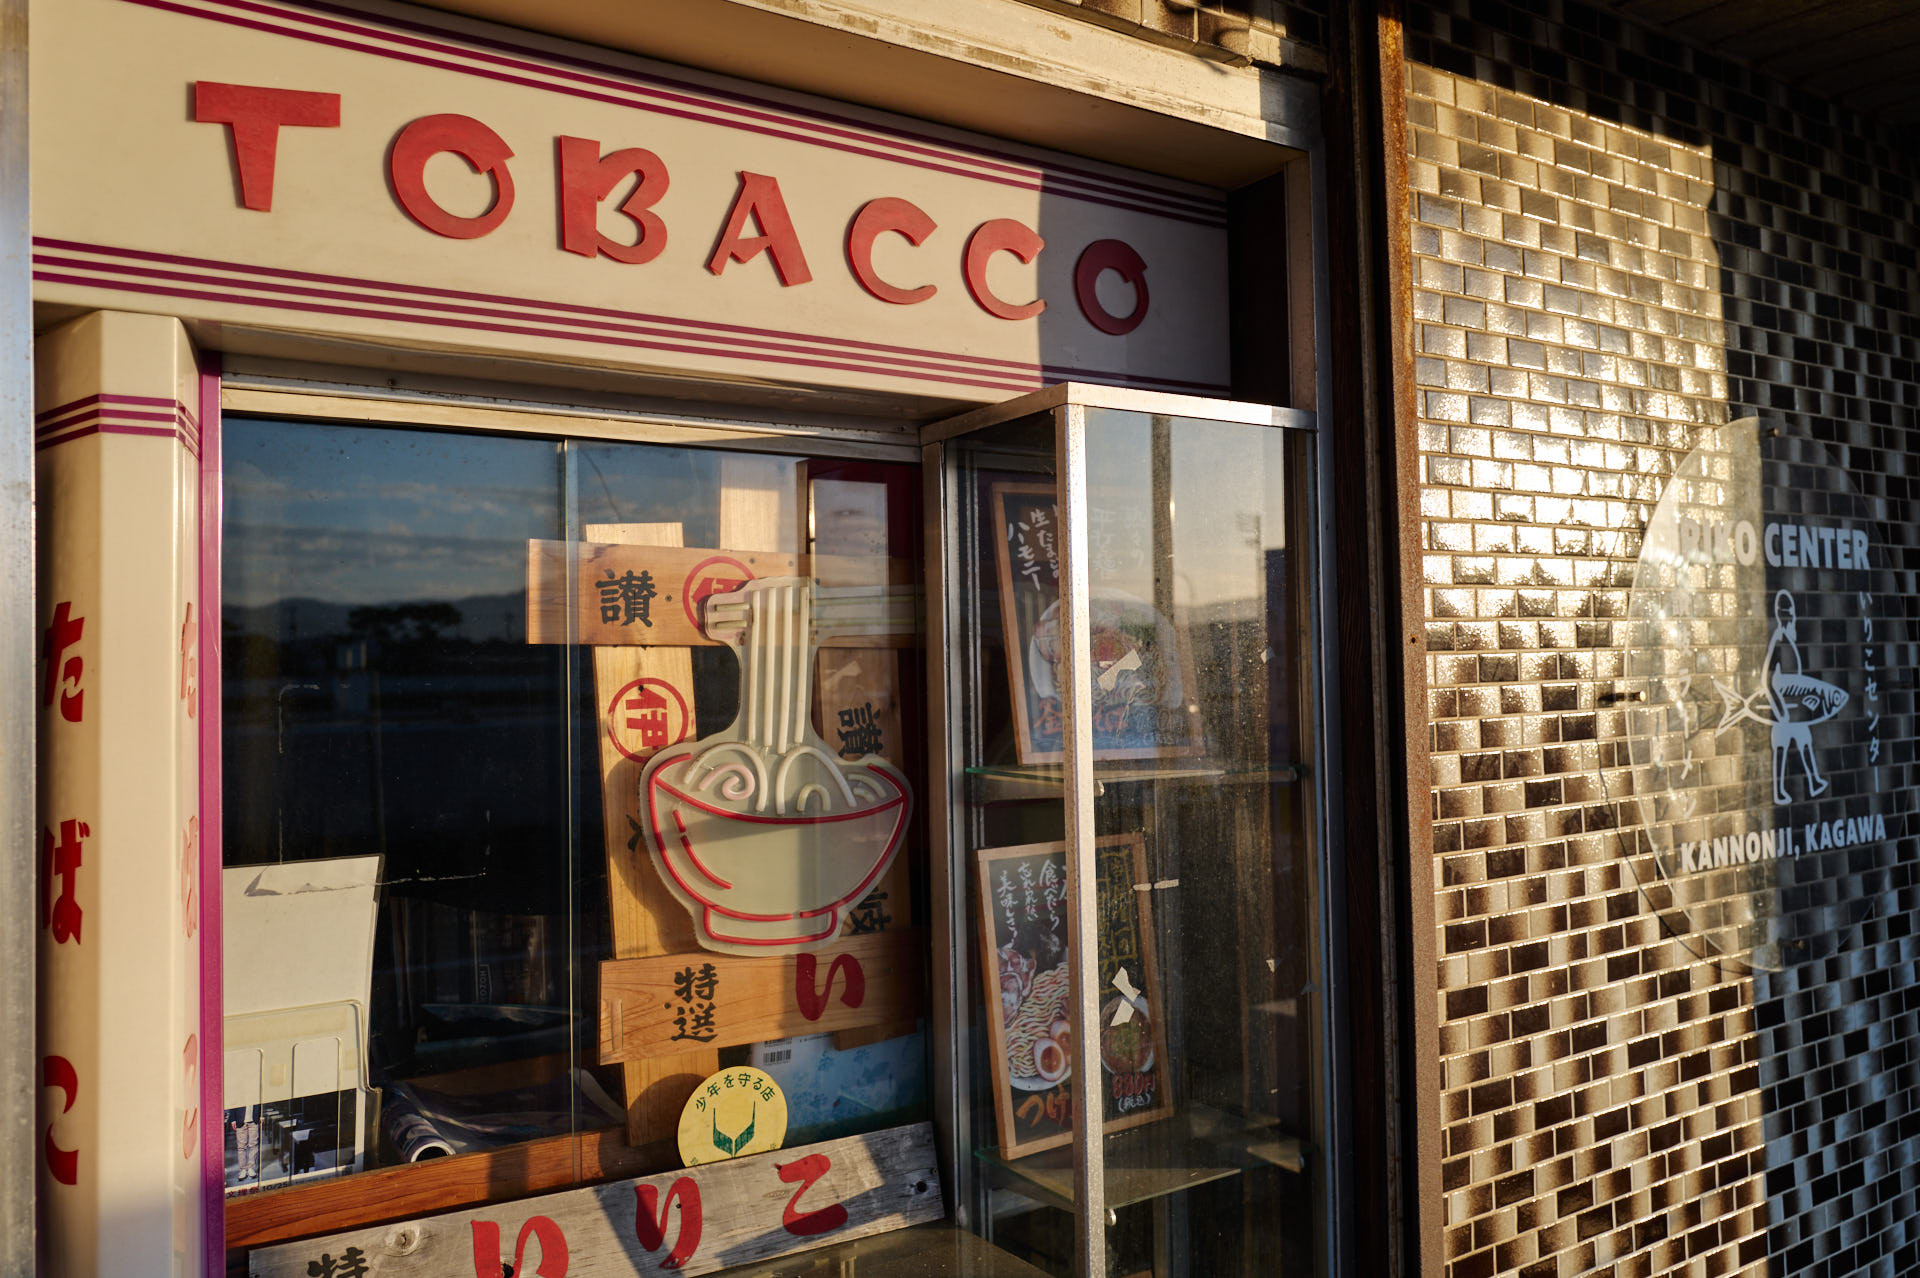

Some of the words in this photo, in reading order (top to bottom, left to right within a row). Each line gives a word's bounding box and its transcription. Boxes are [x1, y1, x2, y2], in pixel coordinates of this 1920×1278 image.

[190, 80, 1150, 336] TOBACCO
[1670, 517, 1758, 568] RIKO
[1764, 522, 1871, 571] CENTER
[1858, 590, 1880, 794] いりこセンター
[1680, 826, 1800, 874] KANNONJI,
[1804, 813, 1887, 852] KAGAWA
[42, 601, 90, 1186] たばこ
[670, 962, 719, 1043] 特選
[795, 952, 866, 1022] い
[694, 1071, 776, 1113] 少年を守る店
[1015, 1083, 1071, 1128] つけ
